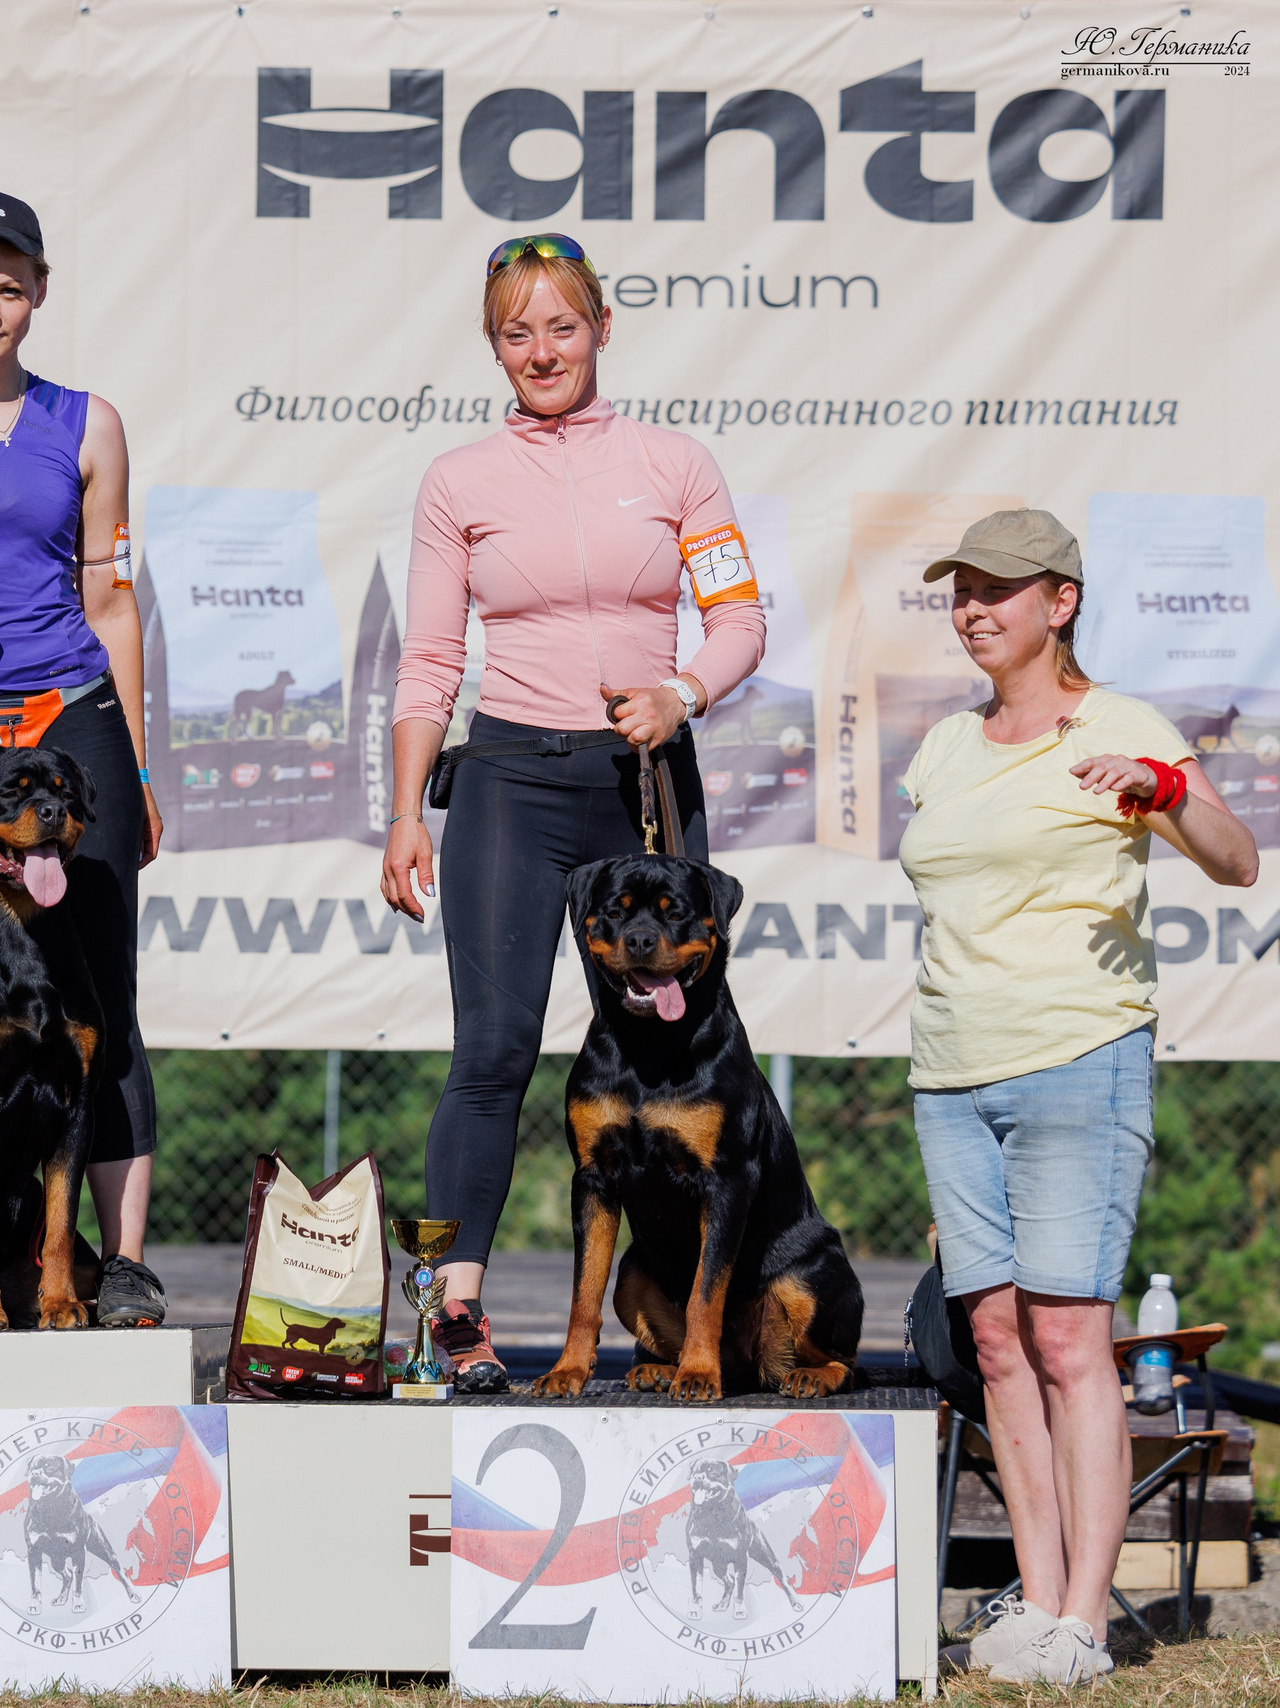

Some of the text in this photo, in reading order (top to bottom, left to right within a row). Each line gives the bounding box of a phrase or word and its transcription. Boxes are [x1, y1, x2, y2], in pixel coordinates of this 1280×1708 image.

[256, 58, 1167, 224] Hanta
[235, 385, 490, 433] Философия
[964, 398, 1179, 427] питания
[685, 529, 732, 554] PROFIFEED
[695, 543, 740, 584] 75
[191, 585, 305, 607] Hanta
[1136, 590, 1251, 614] Hanta
[365, 694, 387, 834] Hanta
[839, 694, 858, 836] Hanta
[66, 1420, 145, 1458] КЛУБ
[151, 1462, 192, 1590] РОССИИ
[621, 1425, 856, 1600] РОТВЕЙЛЕР КЛУБ РОССИИ
[467, 1423, 598, 1650] 2
[16, 1612, 145, 1651] РКФ-НКПР
[676, 1620, 807, 1657] РКФ-НКПР
